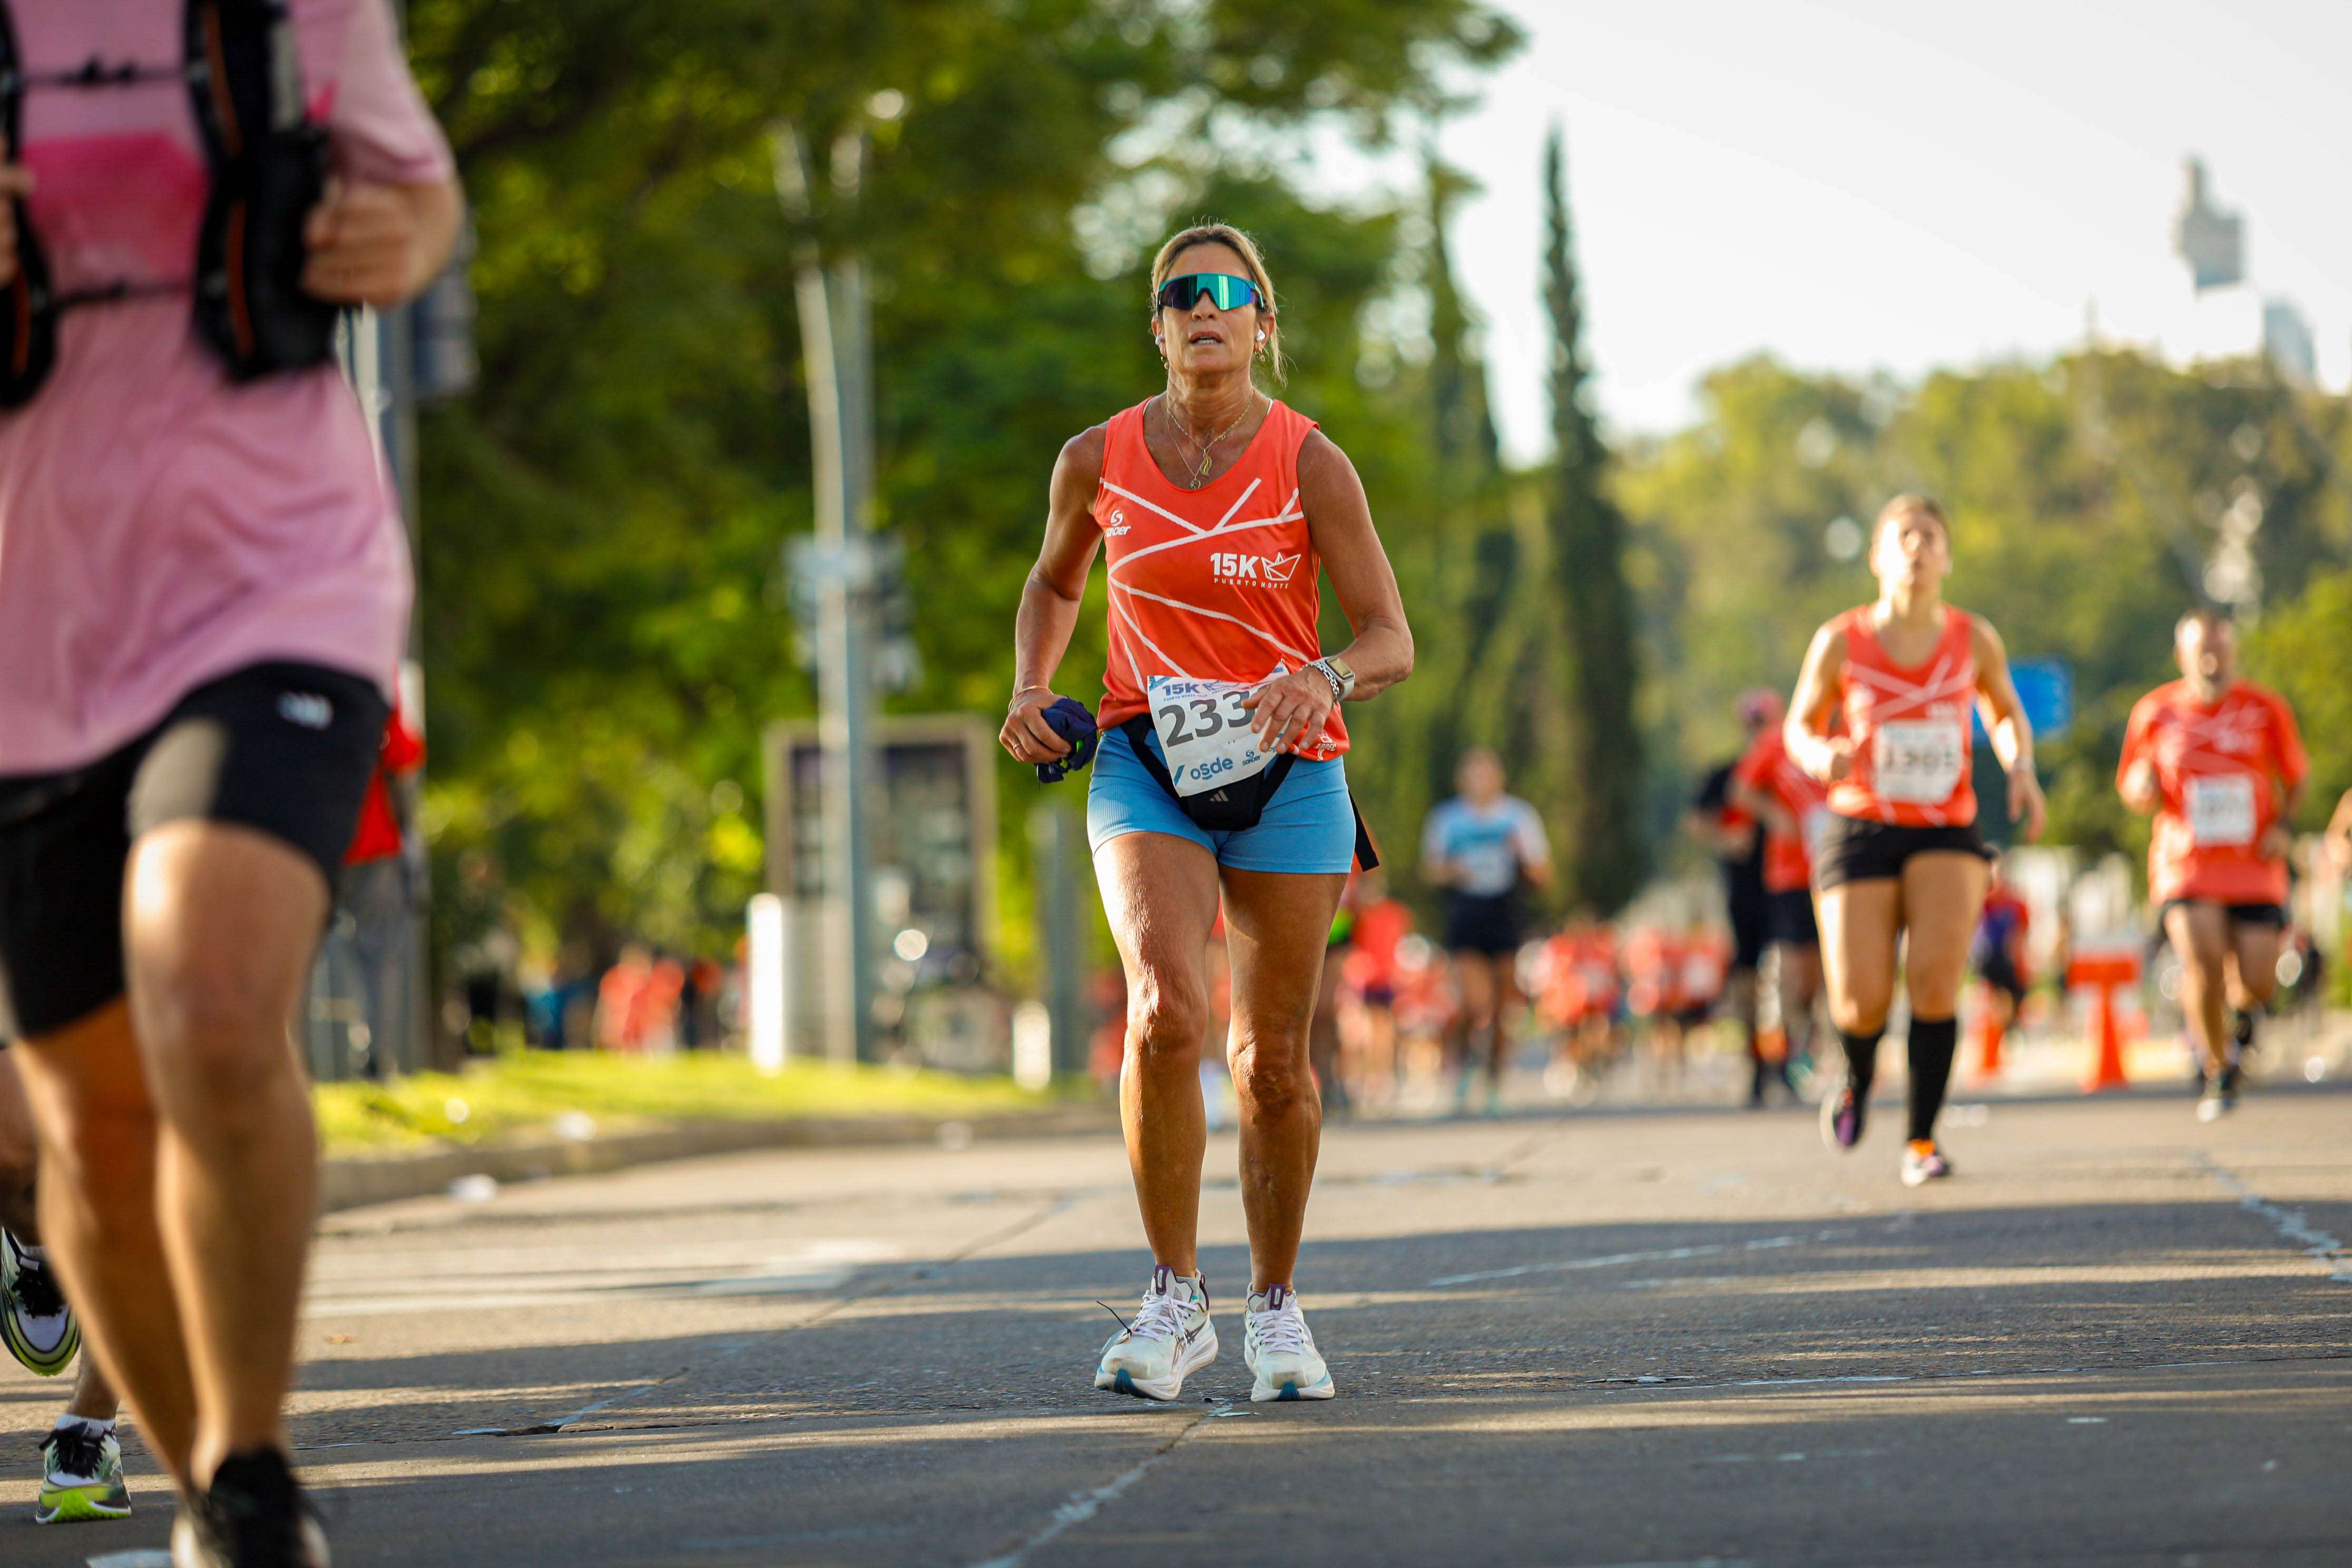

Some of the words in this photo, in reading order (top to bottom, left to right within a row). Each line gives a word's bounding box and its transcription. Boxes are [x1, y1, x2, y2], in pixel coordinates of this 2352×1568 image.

[1210, 552, 1259, 579] 15K
[1214, 577, 1257, 586] PUERTO
[1162, 683, 1200, 695] 15K
[1159, 685, 1270, 748] 233
[1190, 757, 1233, 780] osde
